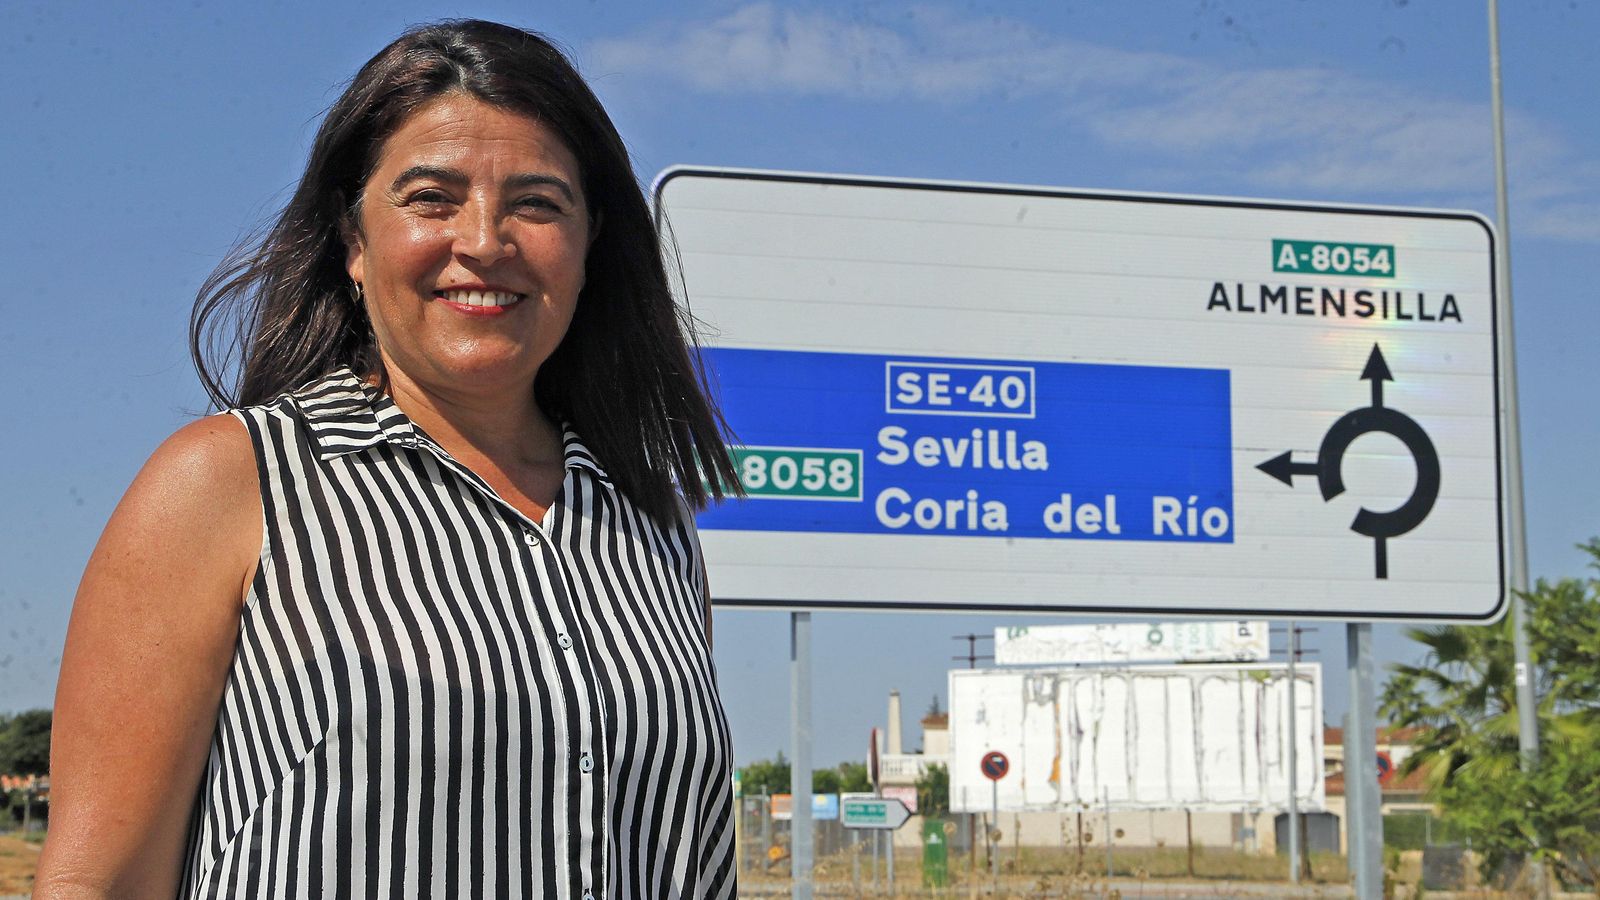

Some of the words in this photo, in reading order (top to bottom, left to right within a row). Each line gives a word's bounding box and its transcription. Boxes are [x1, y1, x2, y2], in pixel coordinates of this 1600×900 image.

[1277, 243, 1391, 274] A-8054
[1207, 281, 1462, 322] ALMENSILLA
[896, 372, 1026, 409] SE-40
[877, 426, 1049, 471] Sevilla
[699, 454, 855, 492] 8058
[875, 487, 1009, 531] Coria
[1043, 493, 1121, 535] del
[1153, 495, 1229, 538] Río
